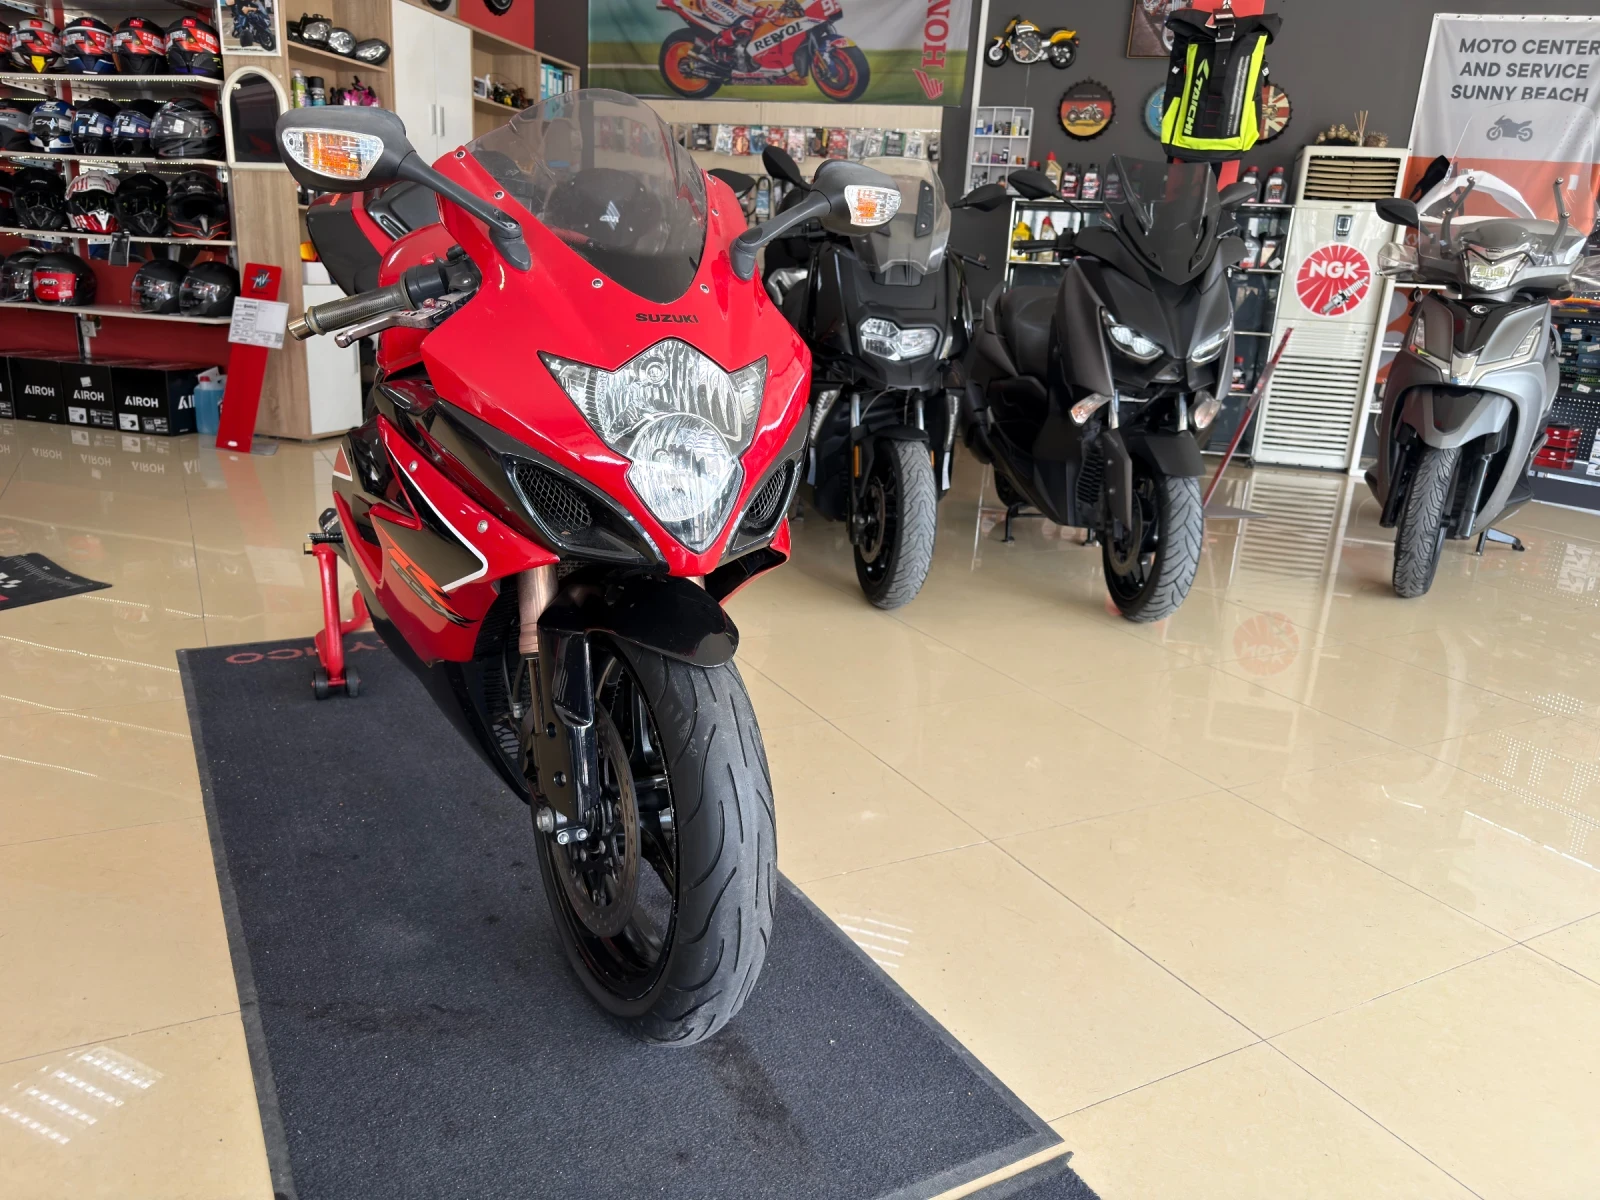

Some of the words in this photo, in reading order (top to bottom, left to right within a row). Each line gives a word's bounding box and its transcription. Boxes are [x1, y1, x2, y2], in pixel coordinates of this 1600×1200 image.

[1459, 38, 1517, 54] MOTO
[1522, 39, 1600, 55] CENTER
[1460, 61, 1501, 77] AND
[1505, 62, 1590, 79] SERVICE
[1450, 85, 1518, 101] SUNNY
[1521, 86, 1589, 103] BEACH
[1309, 260, 1361, 281] NGK
[635, 312, 700, 324] SUZUKI
[24, 384, 55, 397] AIROH
[73, 389, 105, 402] AIROH
[124, 395, 159, 409] AIROH
